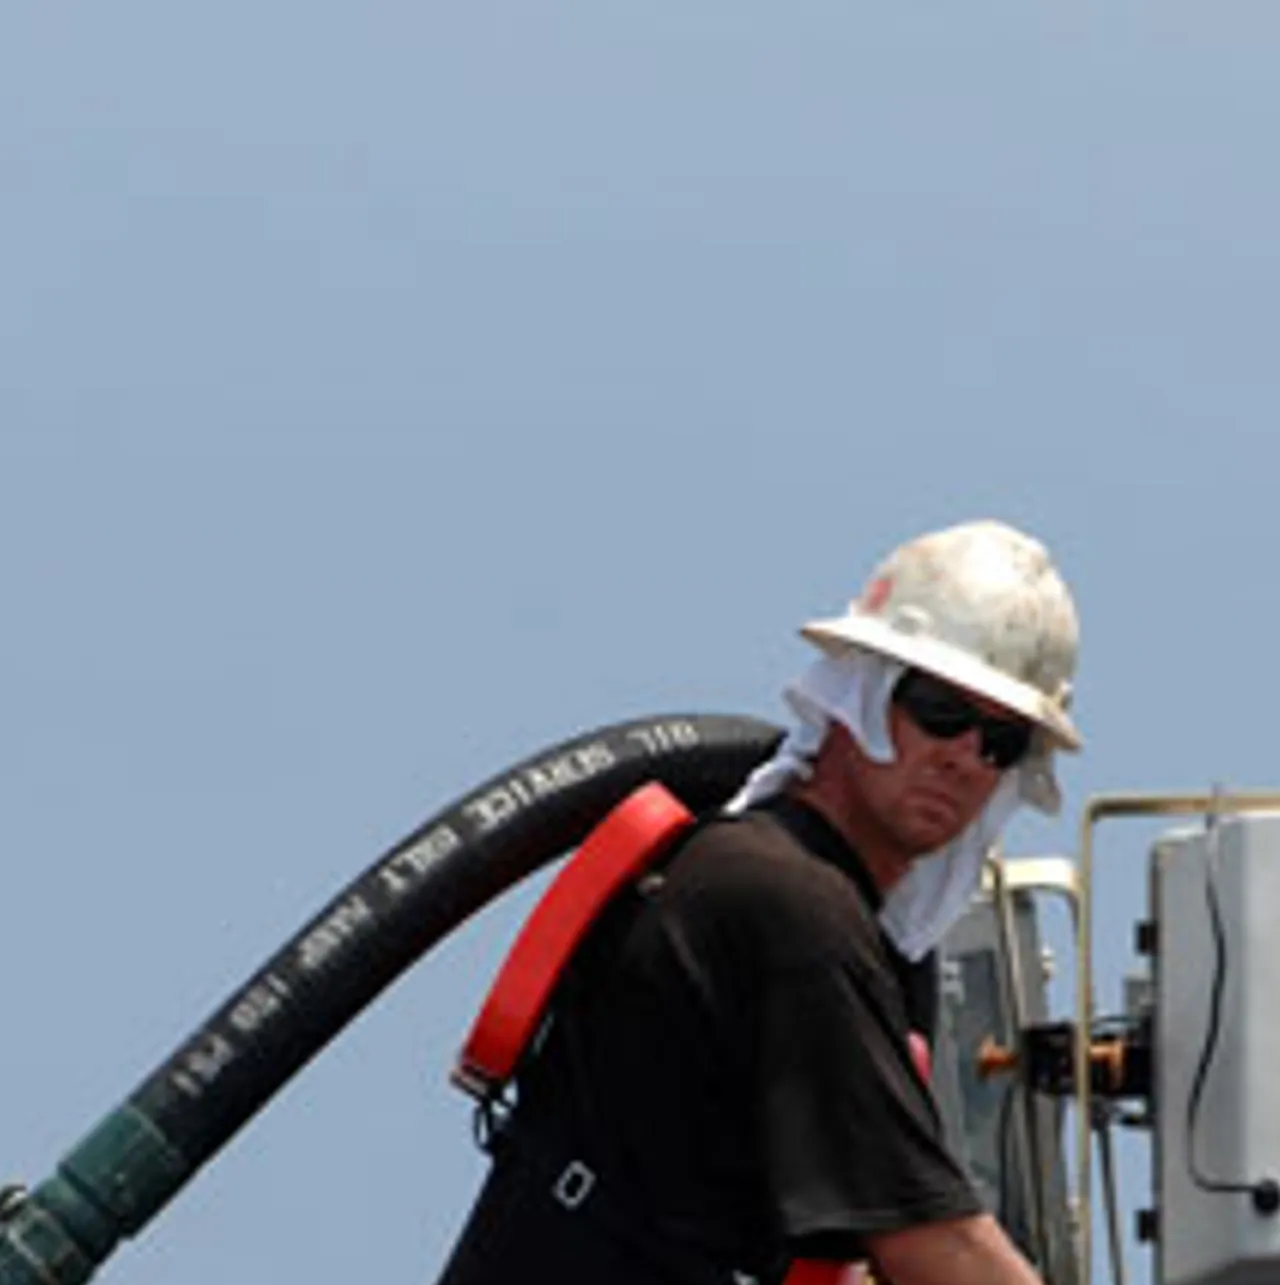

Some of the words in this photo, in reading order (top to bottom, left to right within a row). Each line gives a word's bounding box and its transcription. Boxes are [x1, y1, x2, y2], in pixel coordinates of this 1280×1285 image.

[627, 720, 700, 755] OIL
[467, 742, 615, 831] SERVICE
[378, 824, 458, 893] ONLY
[173, 1037, 233, 1097] PSI
